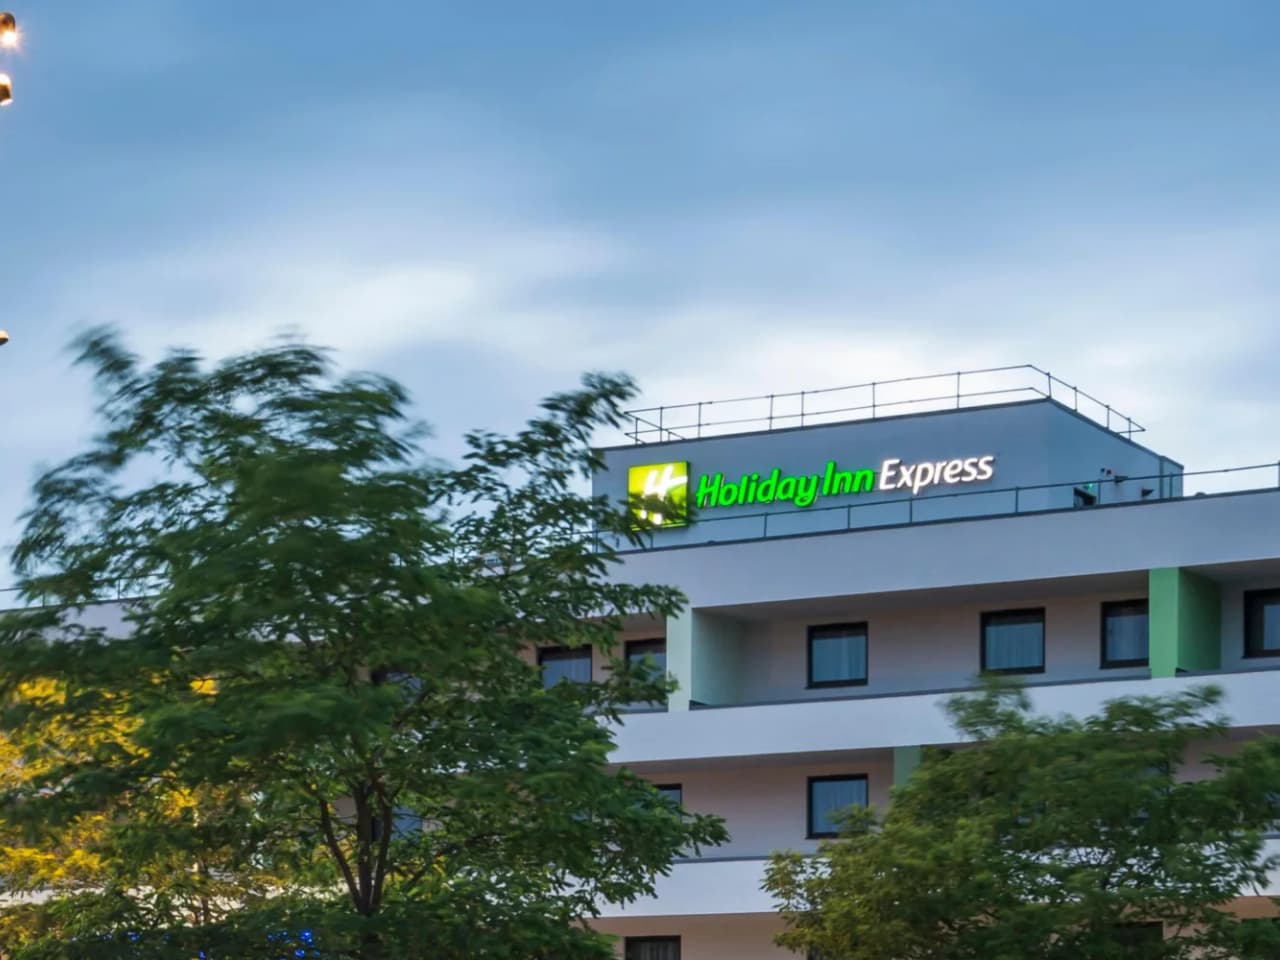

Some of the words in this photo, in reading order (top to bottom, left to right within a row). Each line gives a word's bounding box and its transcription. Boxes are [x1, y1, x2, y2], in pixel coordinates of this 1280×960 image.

[696, 468, 818, 508] Holiday
[822, 460, 875, 496] Inn
[879, 455, 994, 495] Express
